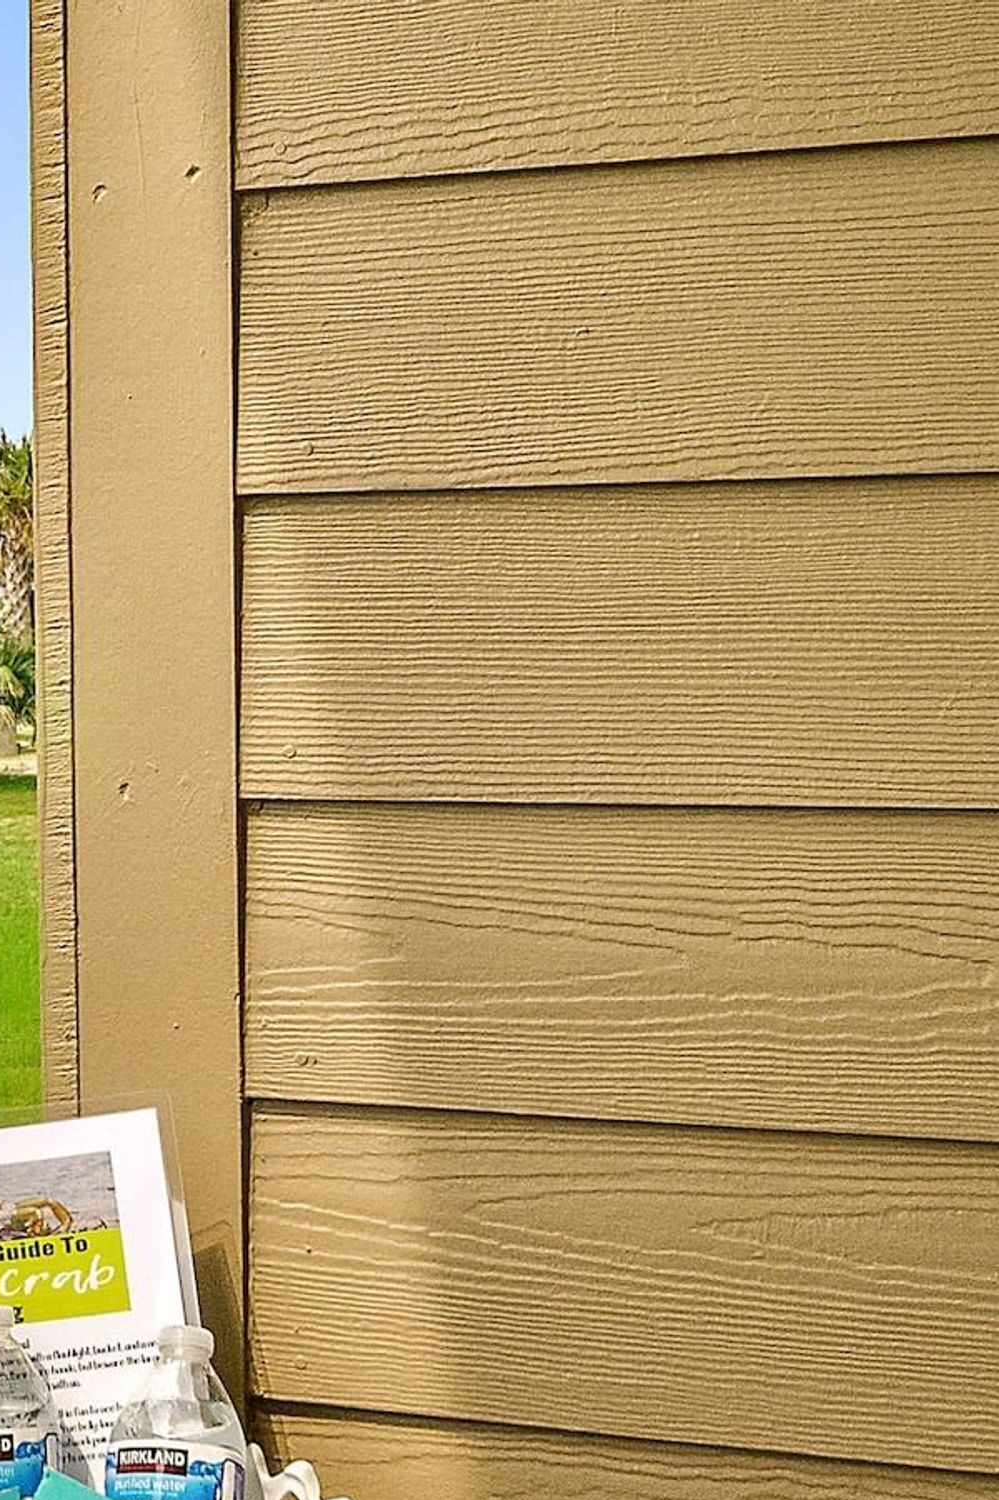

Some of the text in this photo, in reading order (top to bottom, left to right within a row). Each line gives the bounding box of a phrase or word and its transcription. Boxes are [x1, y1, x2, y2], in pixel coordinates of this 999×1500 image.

[62, 1236, 88, 1254] To
[119, 1450, 186, 1466] KIRKLAND
[153, 1479, 186, 1492] water
